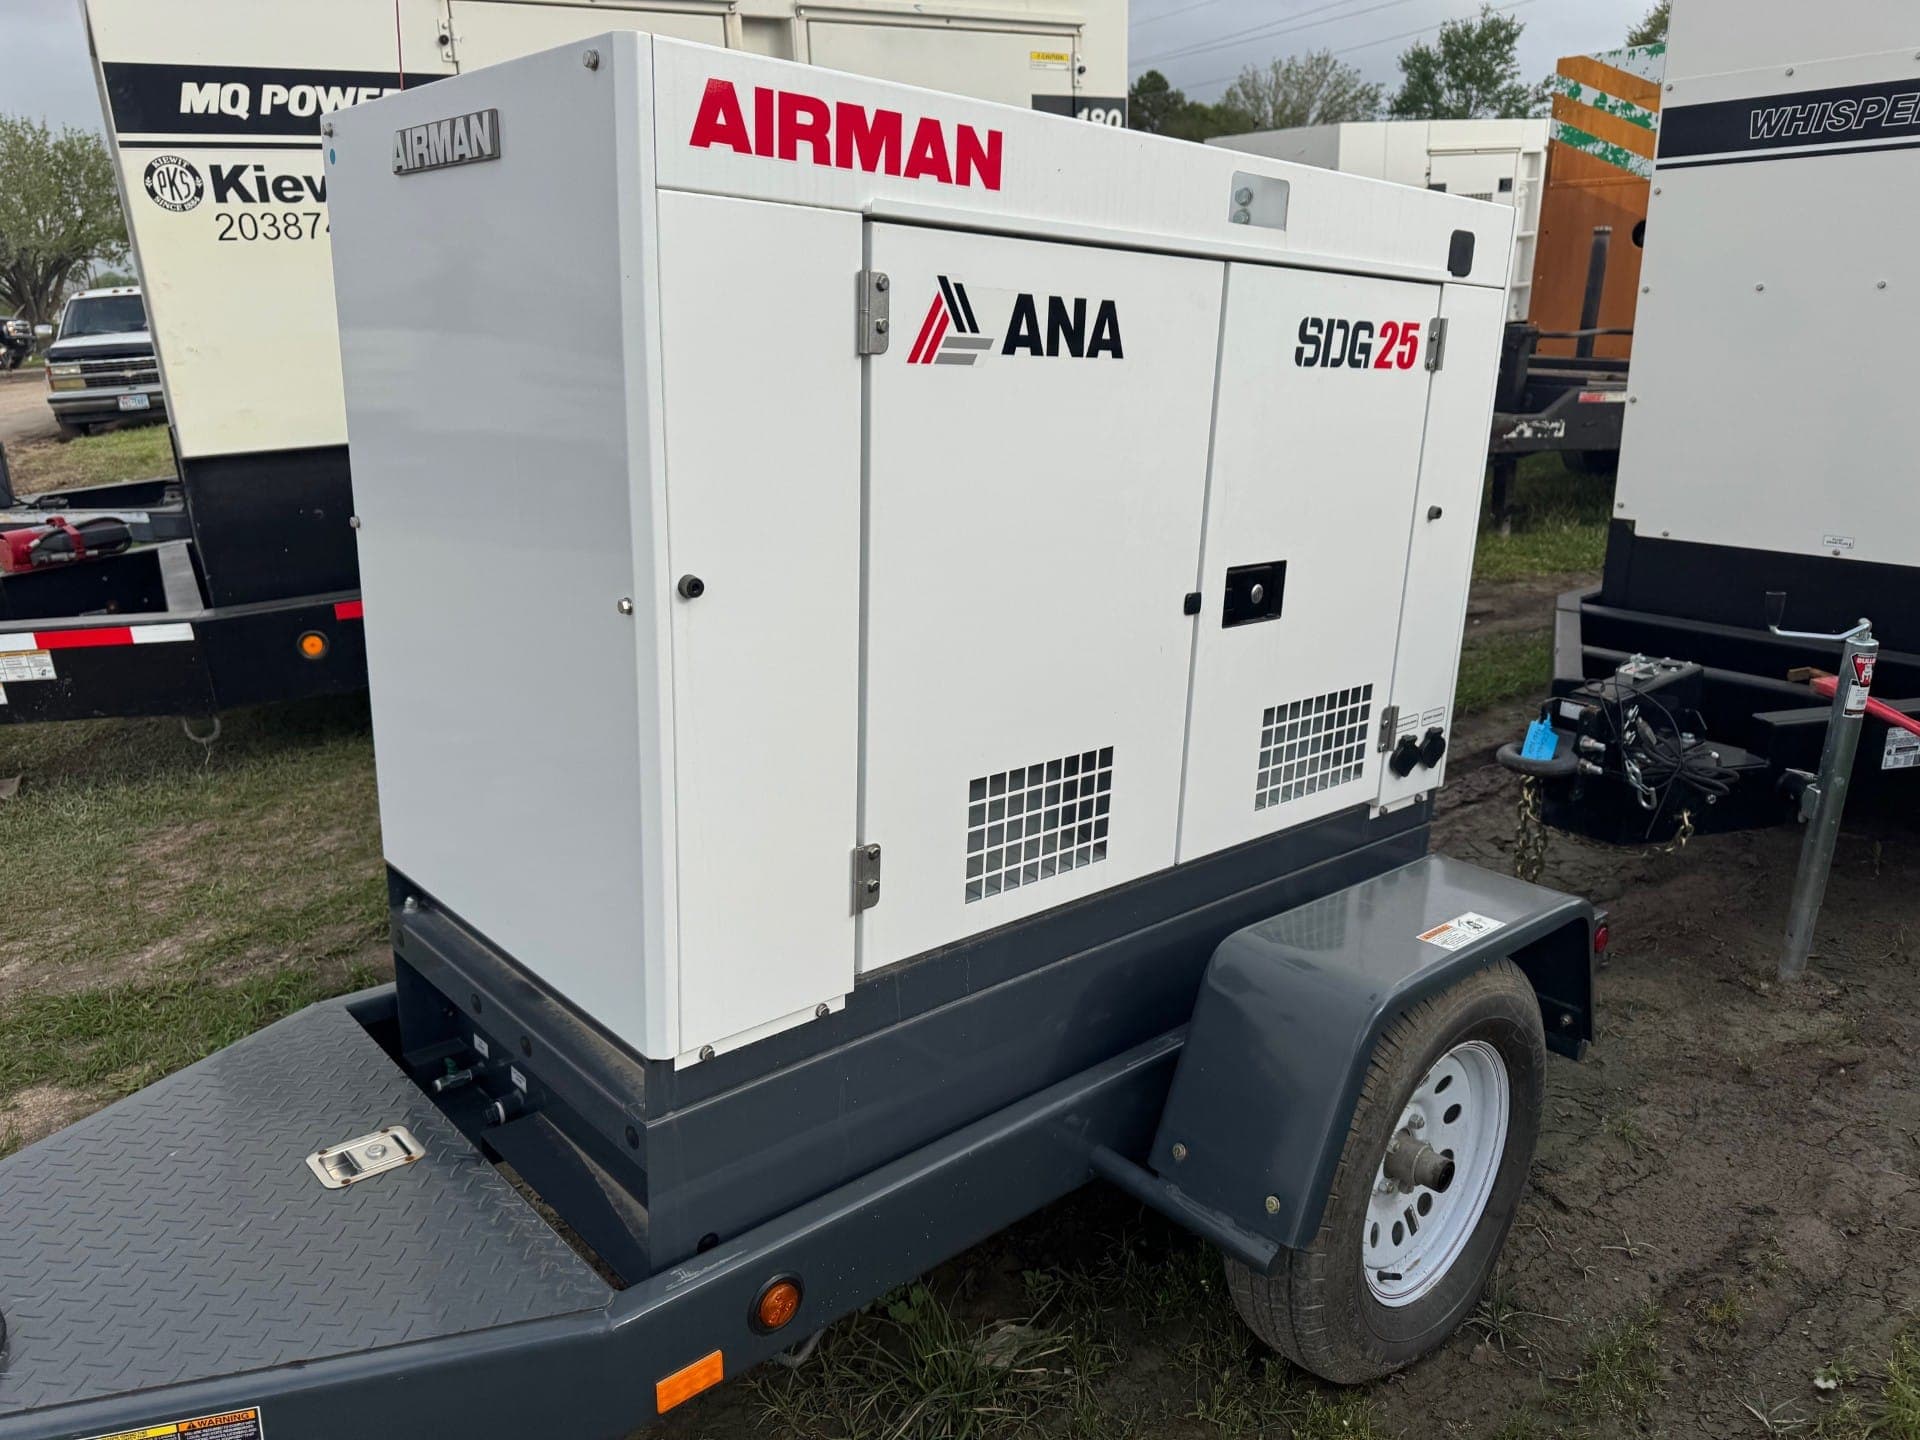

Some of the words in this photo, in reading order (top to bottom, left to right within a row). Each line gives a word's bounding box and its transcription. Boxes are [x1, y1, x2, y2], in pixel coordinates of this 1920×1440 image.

[180, 82, 250, 120] MQ
[260, 84, 402, 117] POW
[1749, 92, 1920, 139] WHISPE
[392, 109, 493, 172] AIRMAN
[689, 77, 1003, 192] AIRMAN
[157, 167, 191, 201] PKS
[215, 212, 331, 241] 20387
[1001, 293, 1124, 359] ANA
[197, 1412, 250, 1428] WARNING
